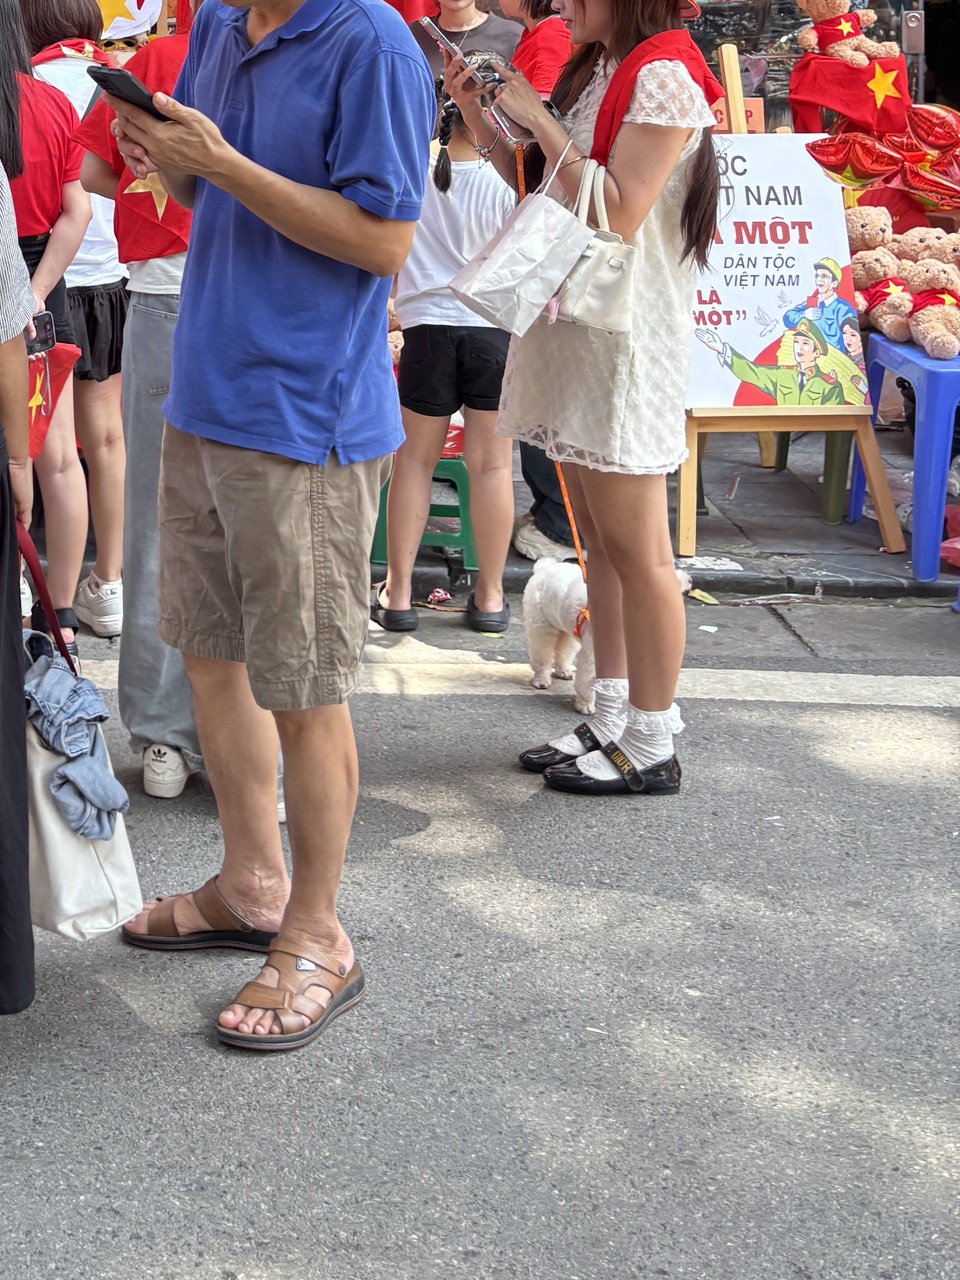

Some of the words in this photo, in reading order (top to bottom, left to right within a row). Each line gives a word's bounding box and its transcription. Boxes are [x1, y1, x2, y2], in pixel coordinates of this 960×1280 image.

[745, 185, 803, 206] NAM
[733, 216, 813, 250] MỘT
[723, 253, 758, 269] DÂN
[763, 253, 796, 271] TỘC
[724, 272, 760, 290] VIỆT
[764, 274, 800, 287] NAM
[696, 285, 723, 305] LÀ
[611, 750, 633, 774] DIOR
